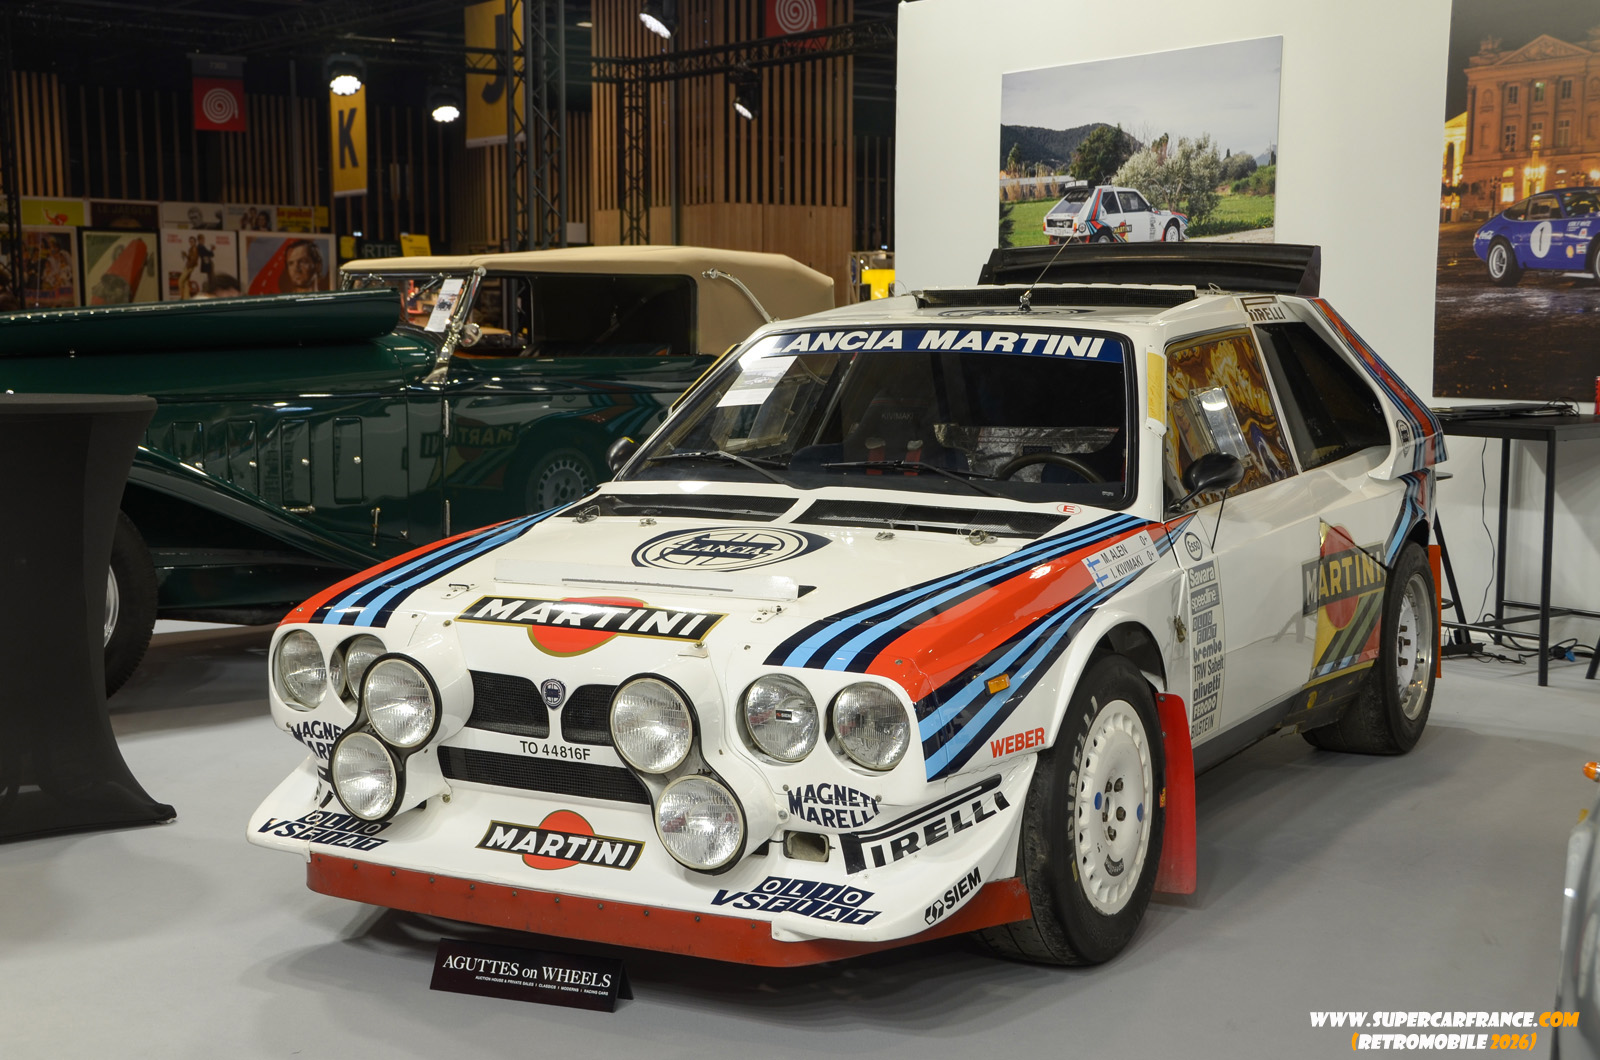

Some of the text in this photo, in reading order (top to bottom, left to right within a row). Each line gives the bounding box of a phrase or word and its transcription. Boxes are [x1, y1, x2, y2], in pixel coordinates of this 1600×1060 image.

[337, 106, 359, 170] K
[917, 329, 1105, 359] MARTINI
[1062, 504, 1075, 514] E
[689, 542, 766, 555] LANCIA
[1187, 539, 1201, 553] Esso
[1188, 566, 1216, 588] Savara
[1305, 550, 1382, 606] MARTINI
[1190, 587, 1218, 611] speedline
[472, 598, 708, 637] MARTINI
[1192, 638, 1223, 663] brembo
[1193, 653, 1224, 682] TRW Sabelt
[1193, 672, 1221, 702] olivetti
[1193, 693, 1218, 718] FERODO
[519, 740, 591, 762] TO 44816F
[990, 726, 1046, 759] WEBER
[837, 773, 1011, 876] PIRELLI
[485, 825, 637, 868] MARTINI
[758, 878, 868, 906] OLIO
[943, 866, 982, 910] SIEM
[442, 954, 613, 989] AGUTTES on WHEELS
